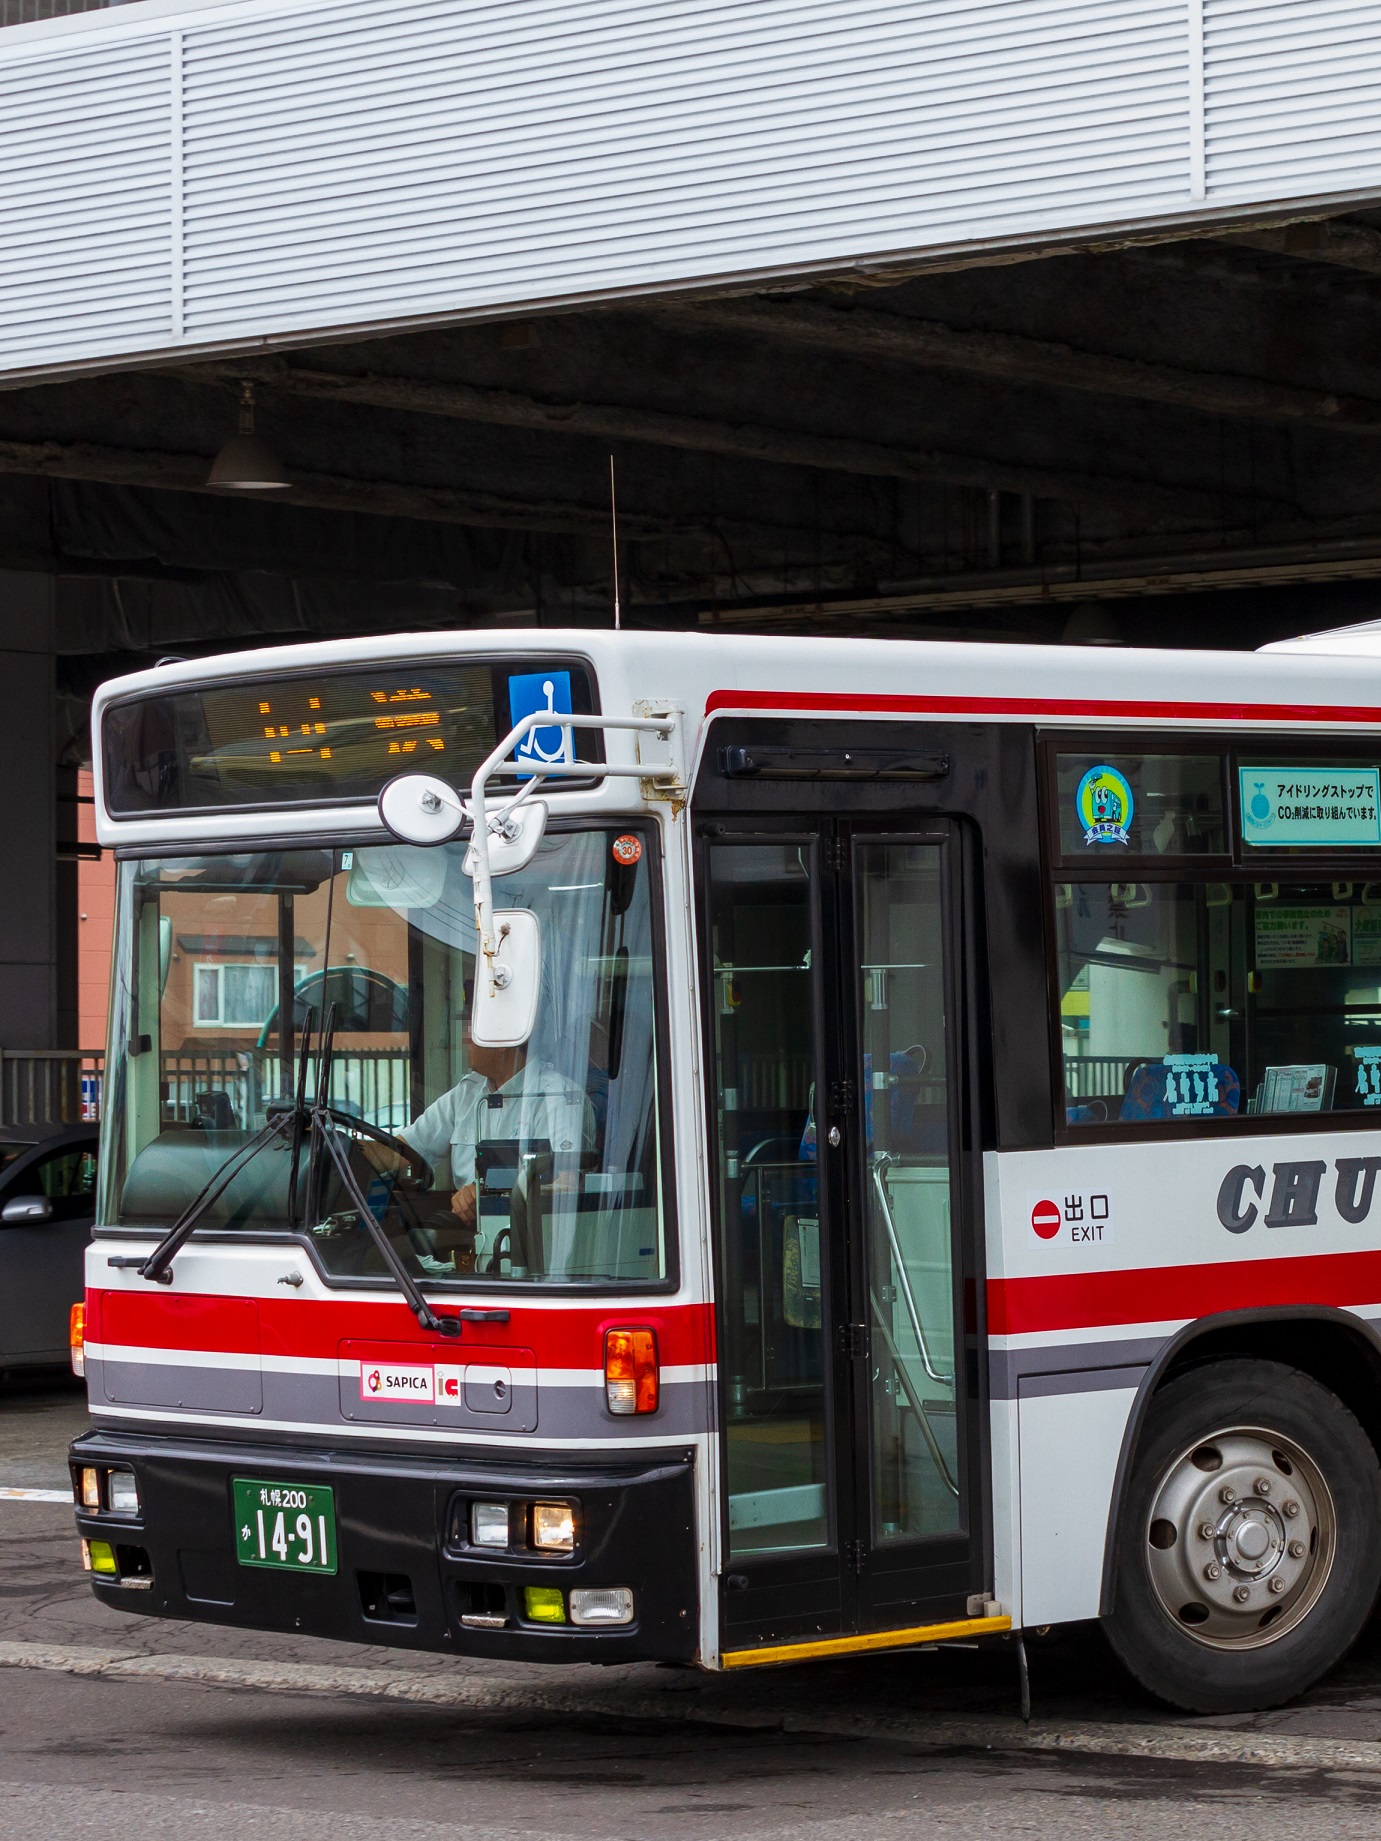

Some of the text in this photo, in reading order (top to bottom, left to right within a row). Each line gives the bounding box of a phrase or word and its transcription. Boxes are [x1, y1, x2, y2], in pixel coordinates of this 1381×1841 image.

[1277, 784, 1374, 798] アイドリングストップで
[622, 846, 632, 856] 30
[1064, 1194, 1109, 1221] 出口
[1071, 1226, 1104, 1241] EXIT
[386, 1376, 428, 1389] SAPICA
[241, 1524, 251, 1541] か
